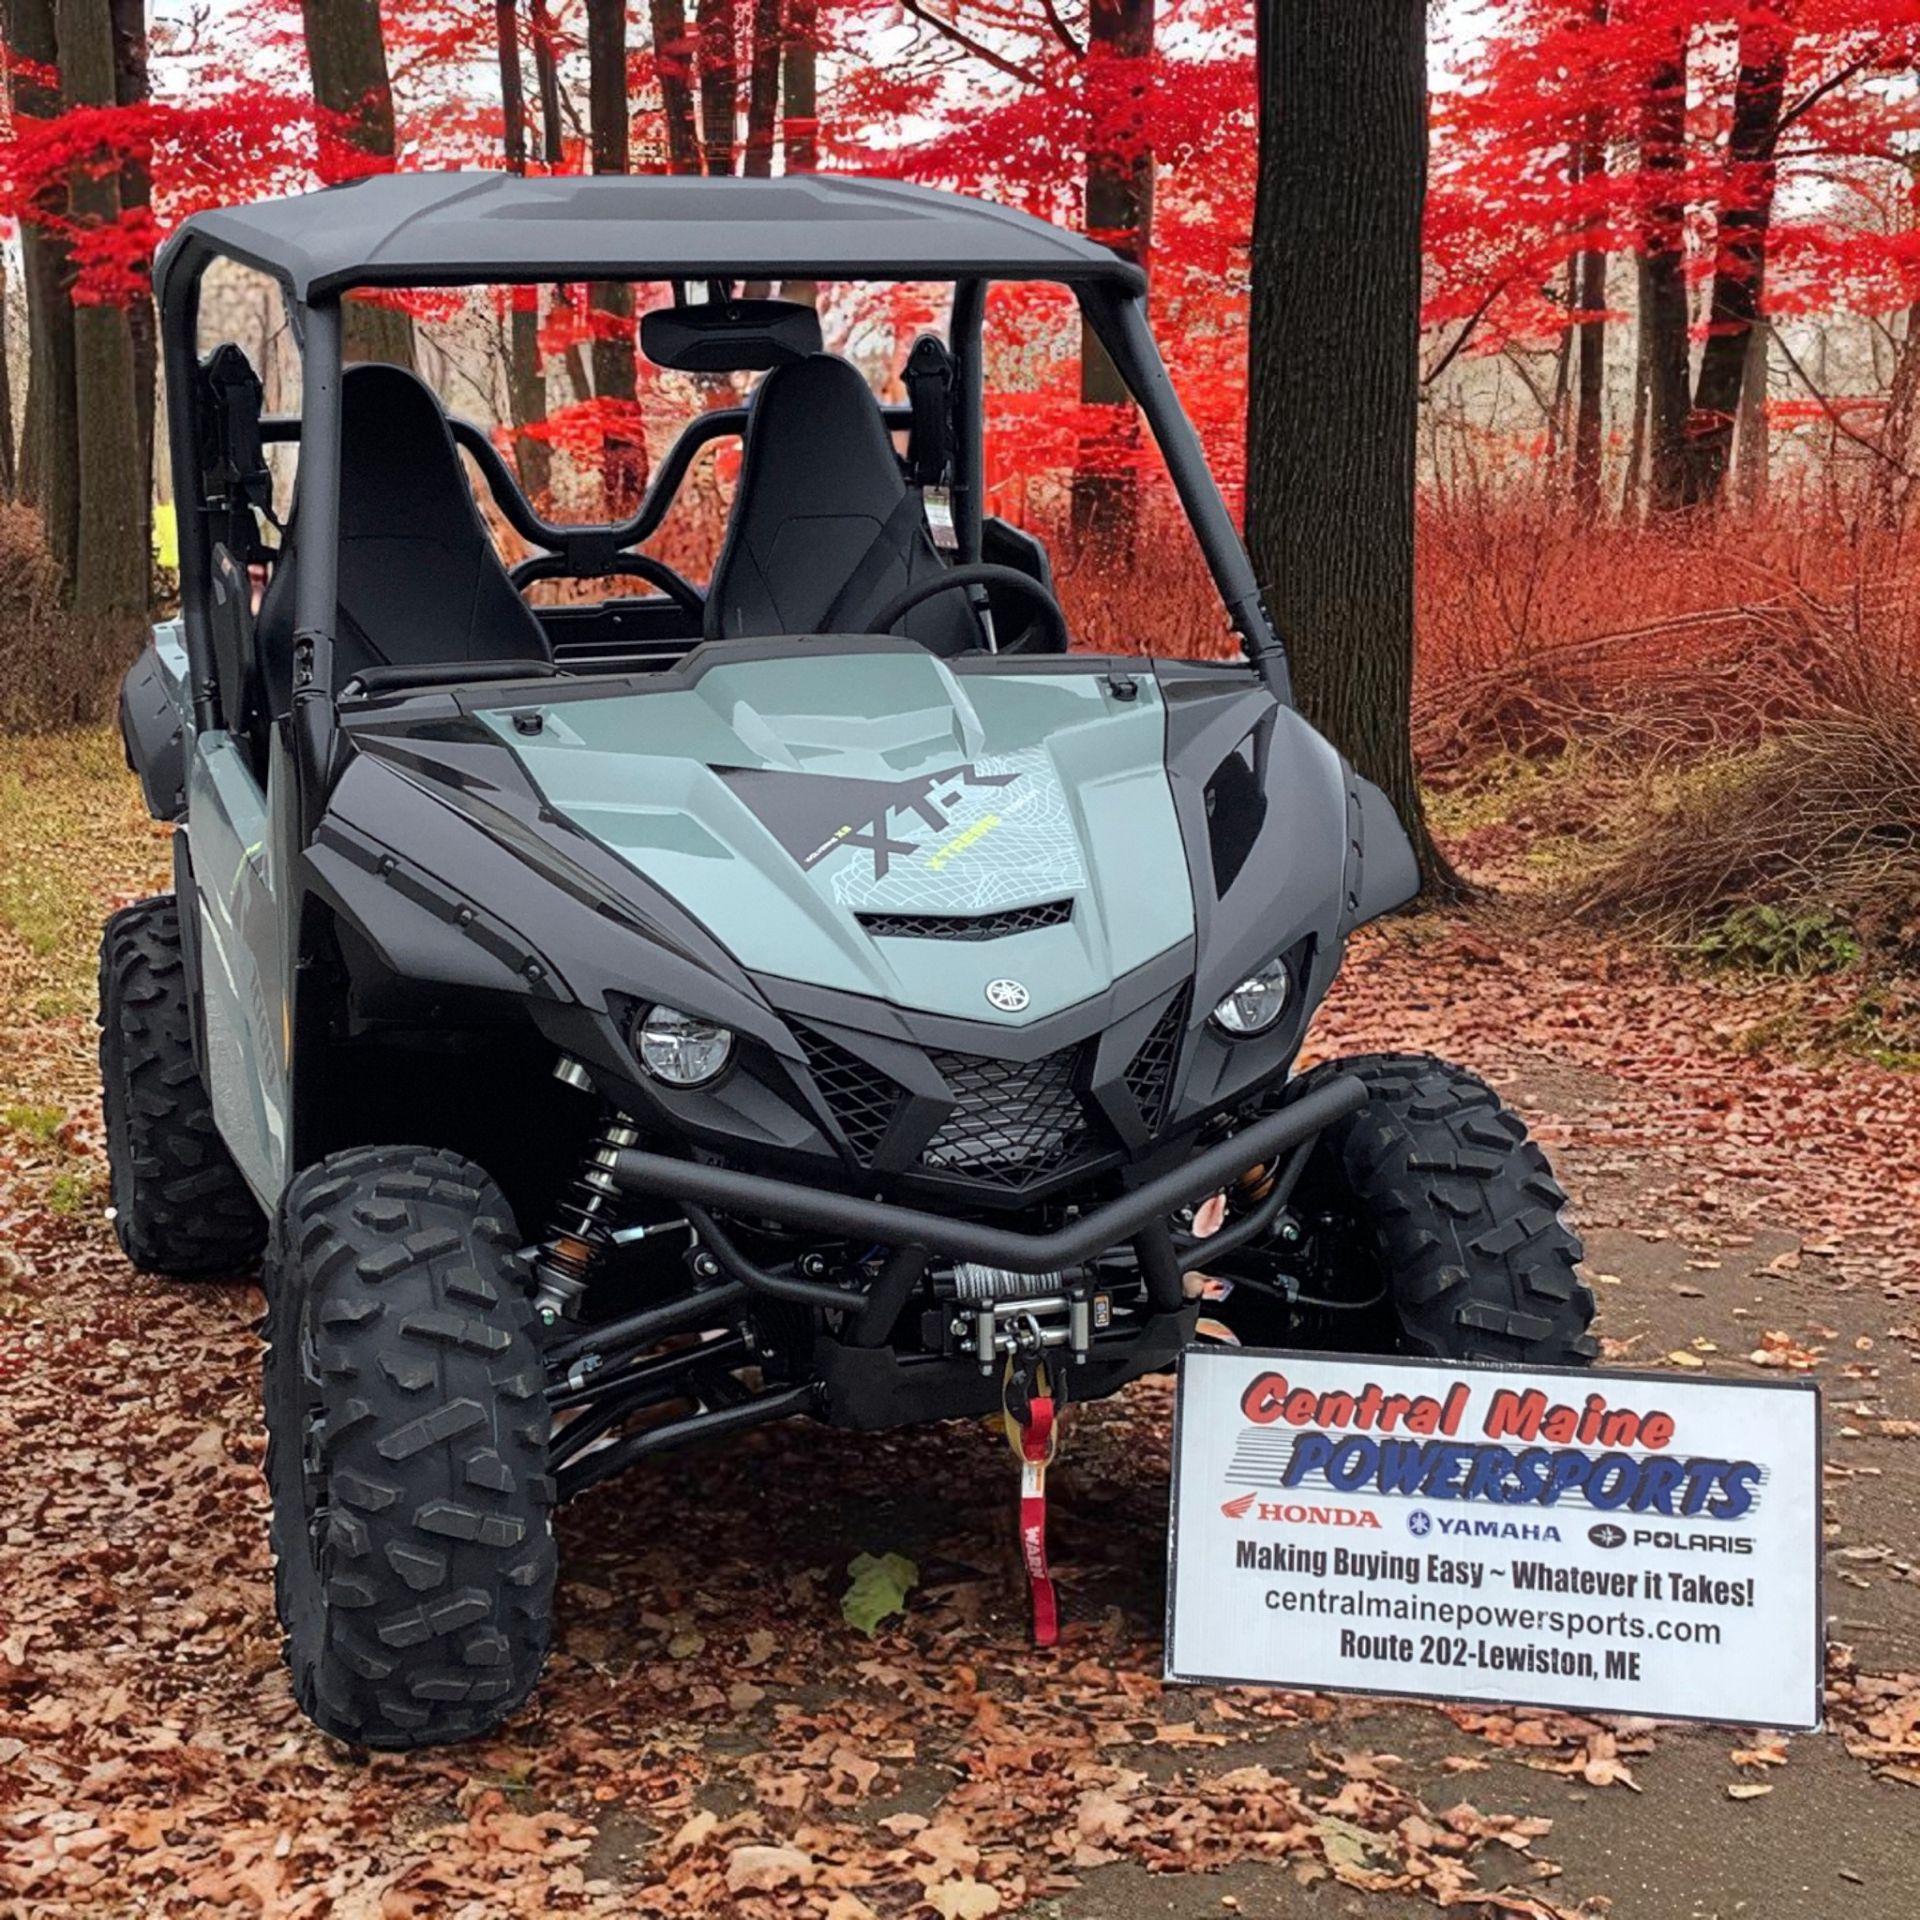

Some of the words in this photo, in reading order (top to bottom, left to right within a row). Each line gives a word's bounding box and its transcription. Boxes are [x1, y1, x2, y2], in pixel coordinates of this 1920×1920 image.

[1241, 1371, 1470, 1436] Central
[1483, 1388, 1675, 1449] Maine
[1280, 1431, 1762, 1520] POWERSPORTS
[1257, 1503, 1382, 1528] HONDA
[1437, 1518, 1561, 1543] YAMAHA
[1025, 1526, 1045, 1578] WARN
[1633, 1530, 1753, 1554] POLARIS
[1236, 1540, 1327, 1577] Making
[1334, 1548, 1420, 1584] Buying
[1427, 1554, 1484, 1588] Easy
[1512, 1561, 1637, 1599] Whatever
[1644, 1571, 1662, 1600] it
[1669, 1572, 1754, 1607] Takes!
[1265, 1588, 1721, 1644] centralmainepowersports.com
[1340, 1629, 1413, 1662] Route
[1420, 1635, 1598, 1681] 202-Lewiston,
[1605, 1650, 1640, 1681] ME
